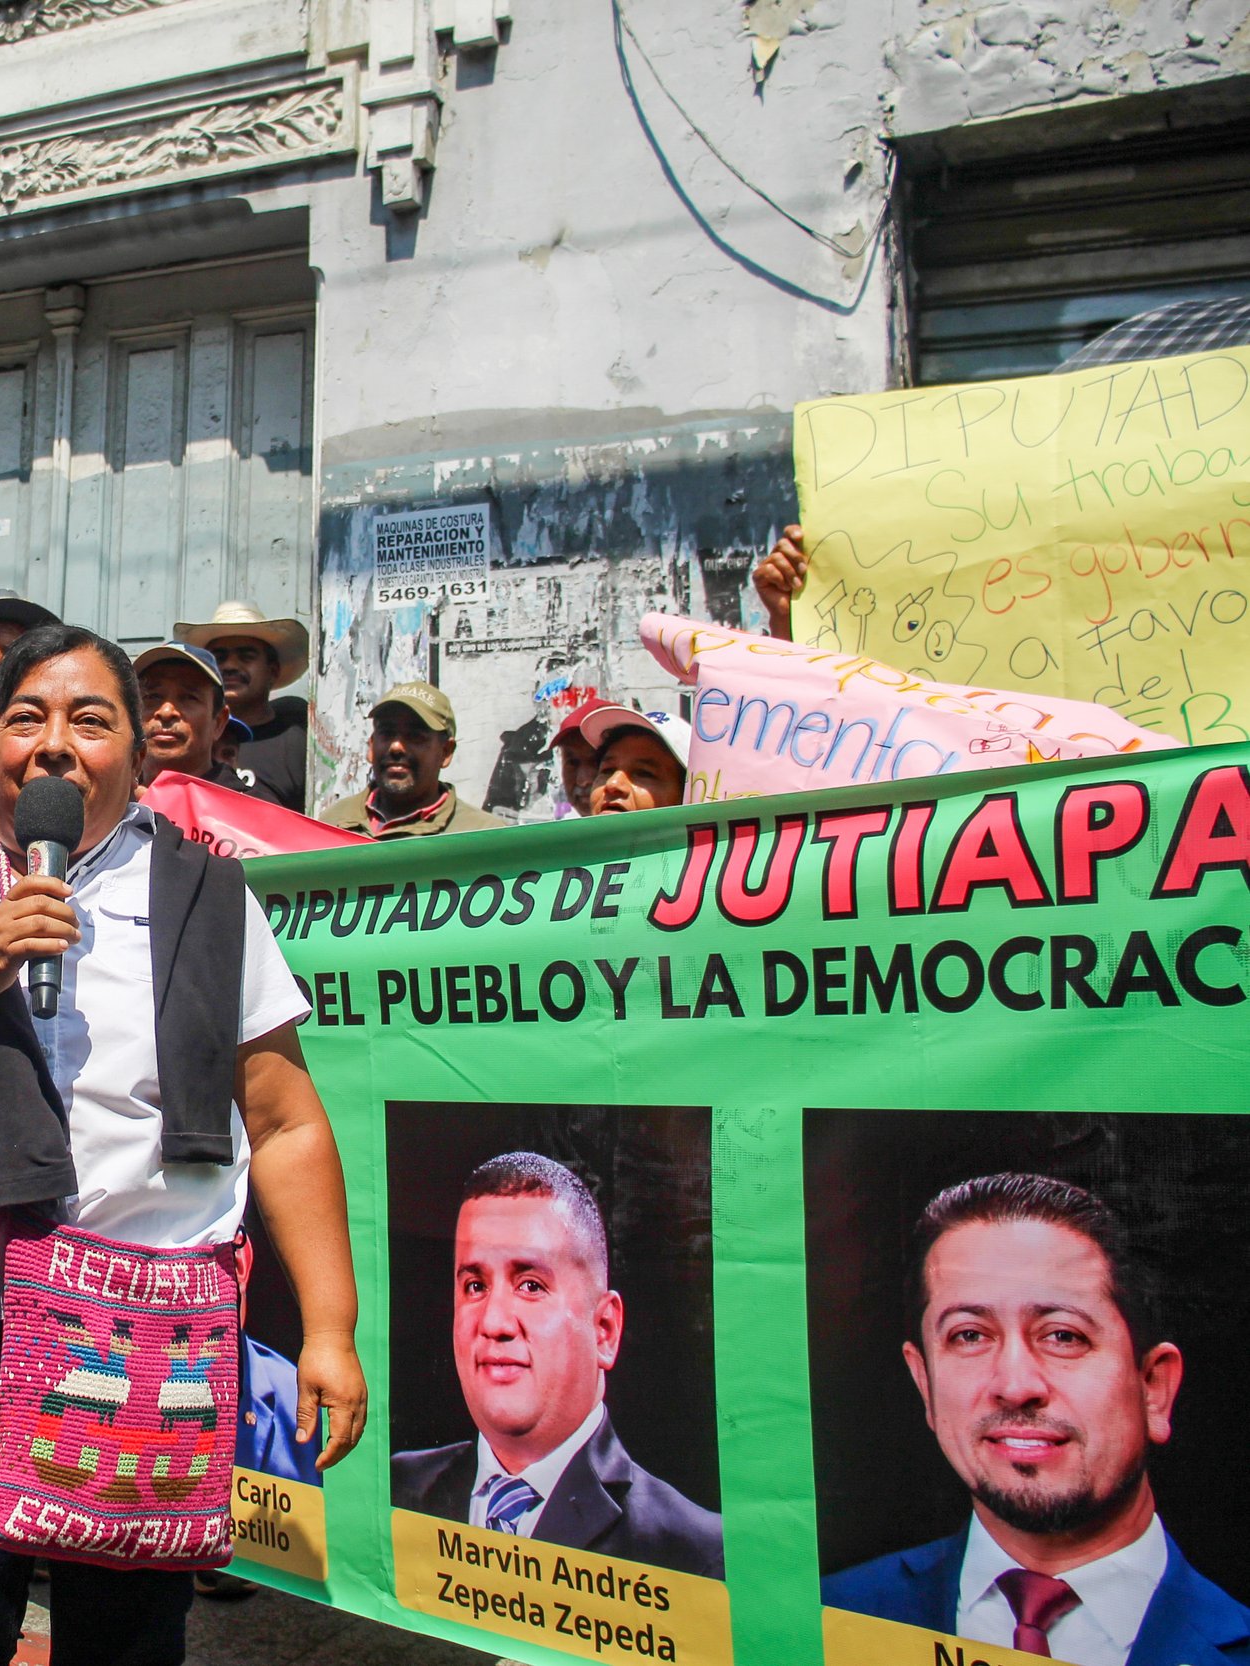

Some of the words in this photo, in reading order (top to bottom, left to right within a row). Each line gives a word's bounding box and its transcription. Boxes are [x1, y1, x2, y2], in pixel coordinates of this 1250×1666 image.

[801, 355, 1249, 492] DIPUTAD
[376, 518, 424, 536] MAQUINAS
[425, 517, 438, 530] DE
[439, 512, 484, 529] COSTURA
[925, 468, 1031, 543] Su
[376, 539, 485, 564] MANTENIMIENTO
[377, 528, 470, 549] REPARACION
[474, 525, 485, 539] Y
[376, 564, 398, 577] TODA
[399, 560, 426, 574] CLASE
[377, 575, 409, 589] DOMESTICAS
[409, 573, 435, 586] GARANTIA
[435, 570, 457, 584] TECNICO
[457, 567, 487, 581] INDUSTRIAL
[981, 556, 1052, 615] es
[378, 580, 487, 603] 5469-1631
[1008, 636, 1060, 680] a
[1092, 648, 1195, 709] del
[391, 685, 437, 704] DRAKE
[264, 869, 543, 941] DIPUTADOS
[549, 861, 631, 923] DE
[646, 763, 1250, 932] JUTIAPA
[377, 960, 587, 1026] PUEBLO
[592, 956, 640, 1021] Y
[657, 952, 746, 1020] LA
[236, 1475, 292, 1514] Carlo
[436, 1527, 542, 1583] Marvin
[550, 1554, 671, 1613] Andrés
[436, 1571, 546, 1629] Zepeda
[553, 1601, 678, 1664] Zepeda
